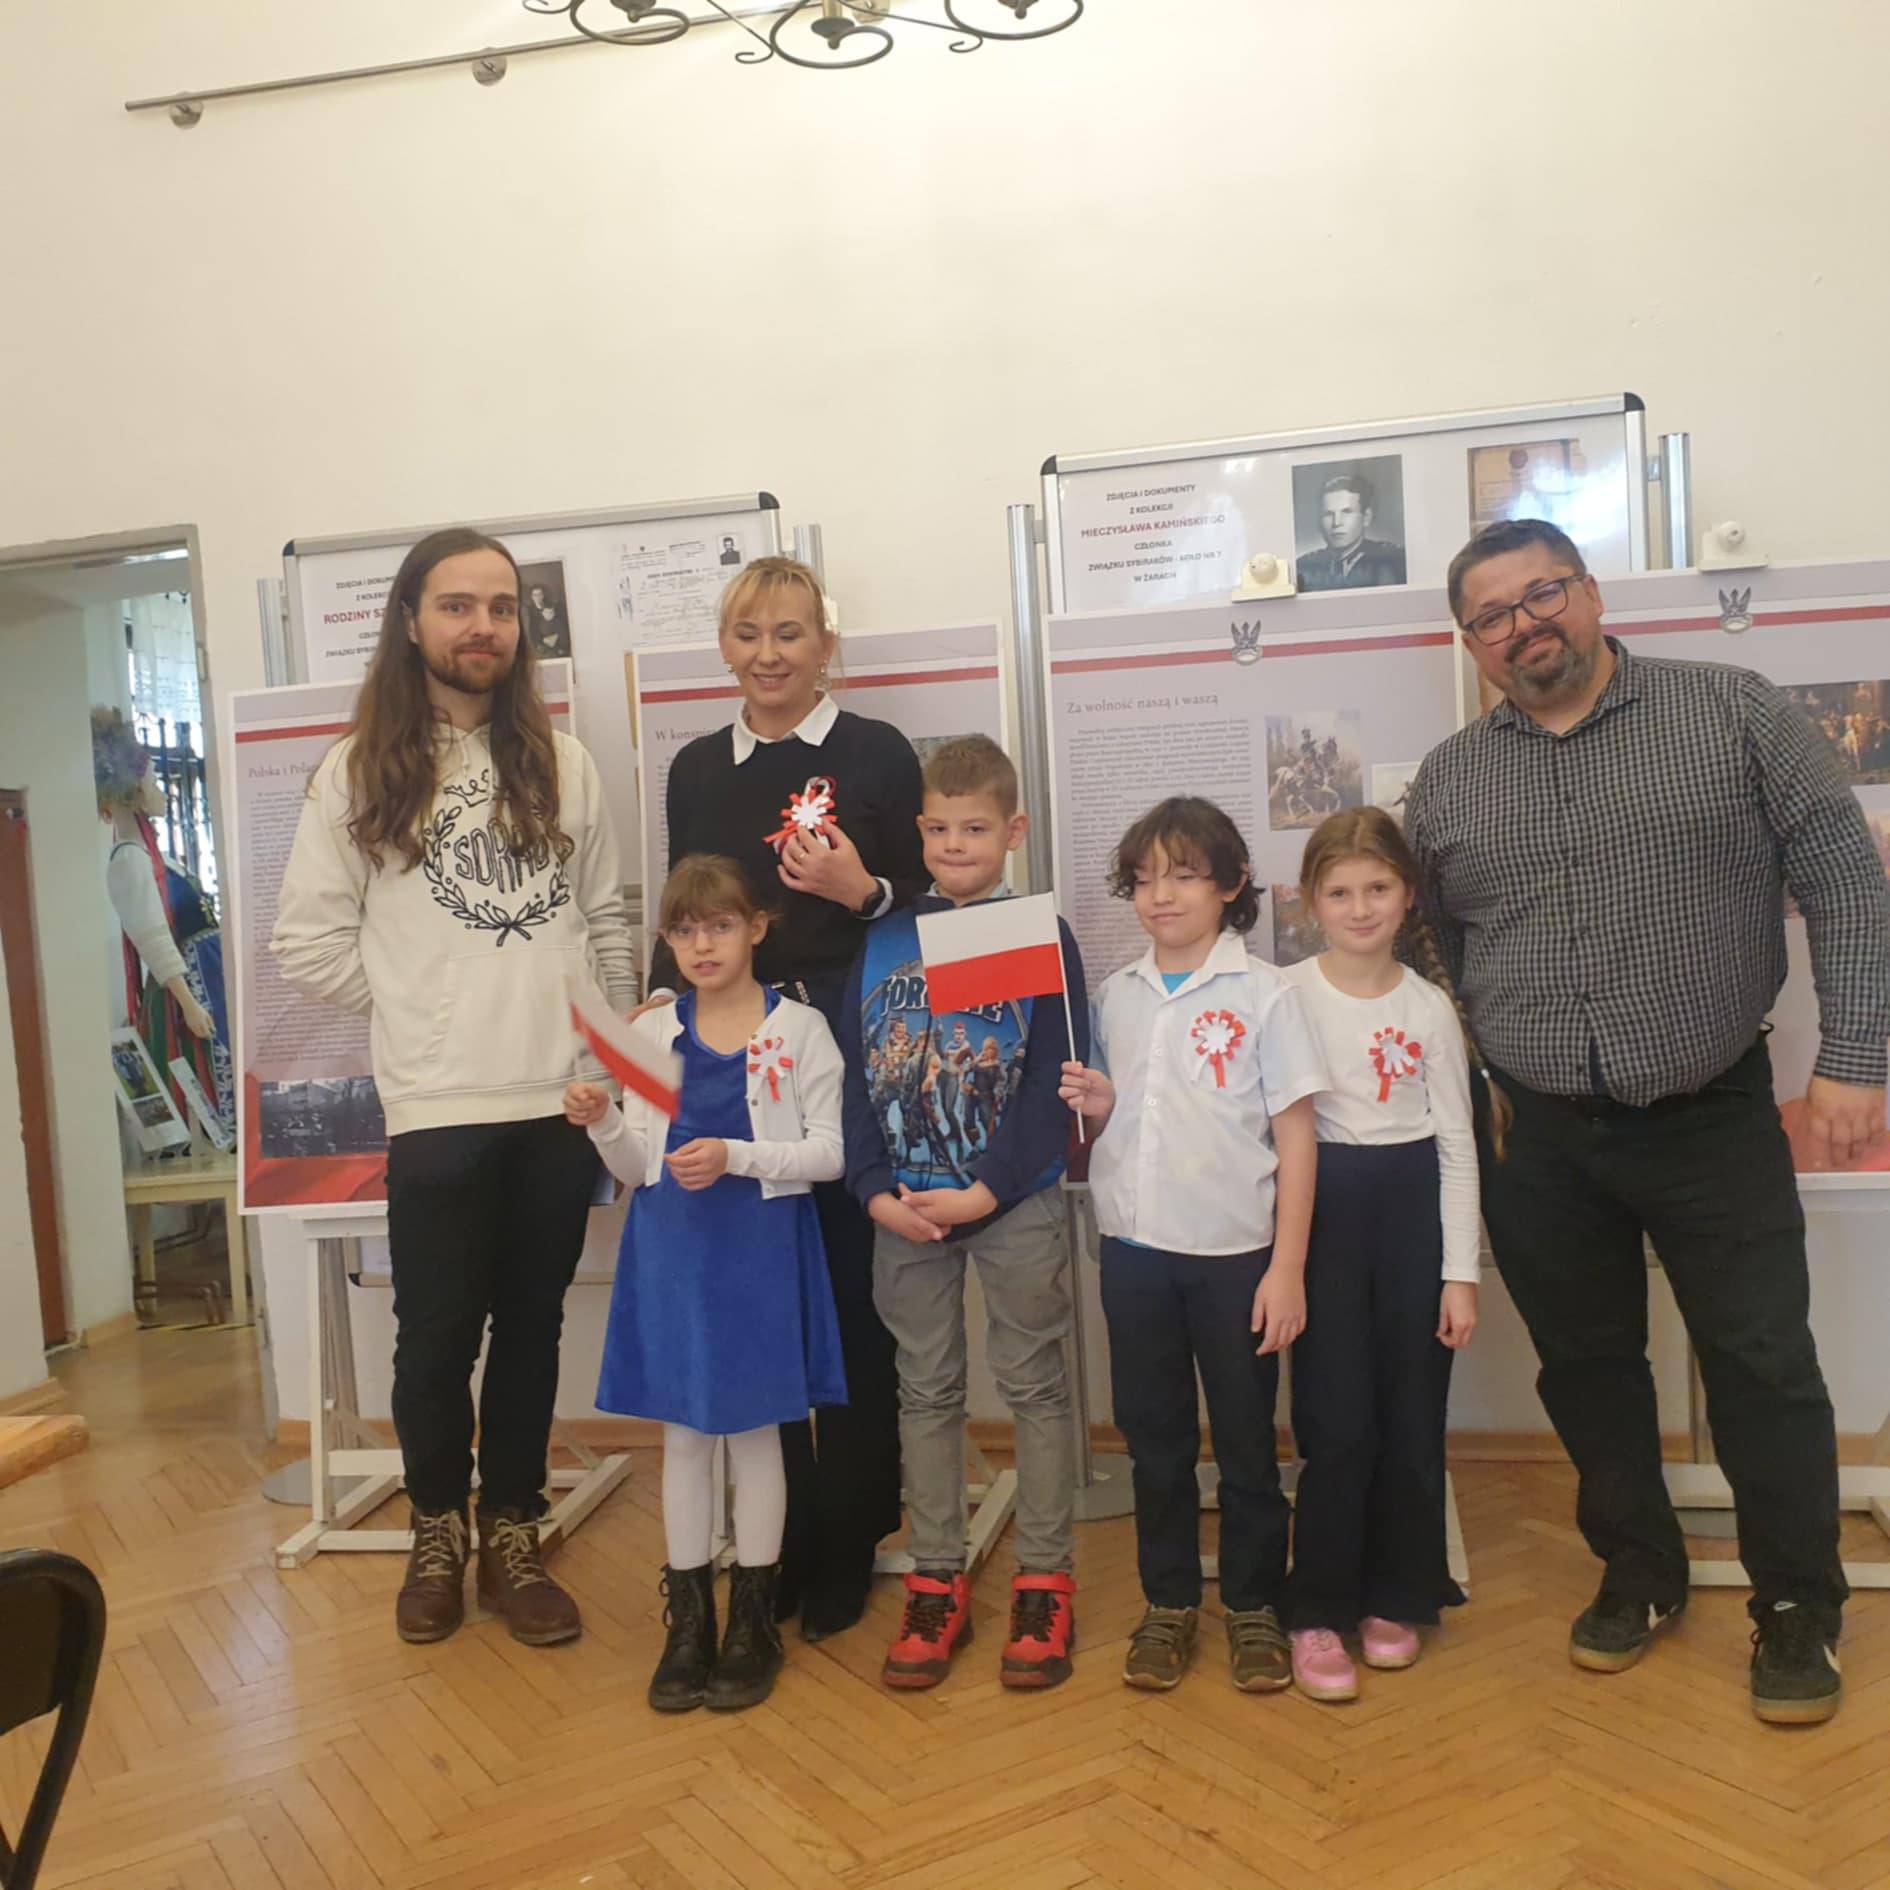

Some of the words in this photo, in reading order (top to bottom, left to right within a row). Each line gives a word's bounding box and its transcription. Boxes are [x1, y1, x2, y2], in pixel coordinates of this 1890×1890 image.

[1144, 484, 1196, 497] DOKUMENTY
[1081, 523, 1152, 538] MIECZYSŁAWA
[324, 609, 371, 624] RODZINY
[1067, 701, 1082, 714] Za
[1085, 698, 1134, 713] wolność
[1137, 697, 1171, 712] naszą
[1182, 694, 1219, 708] waszą
[655, 730, 666, 741] W
[248, 763, 281, 778] Polska
